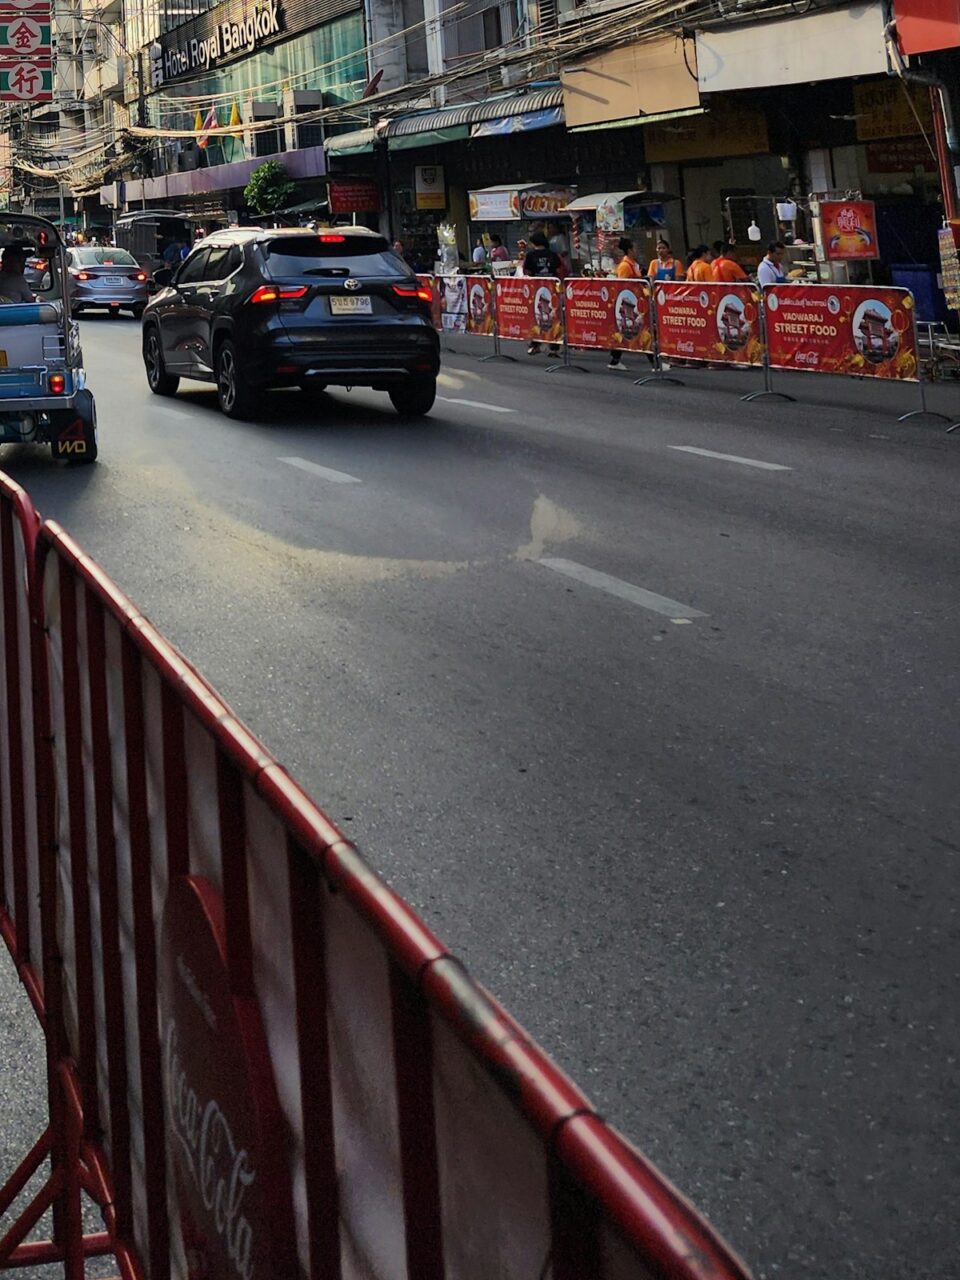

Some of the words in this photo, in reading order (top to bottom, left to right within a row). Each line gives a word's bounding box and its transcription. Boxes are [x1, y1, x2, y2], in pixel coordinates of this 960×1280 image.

[164, 41, 190, 78] Hotel
[191, 26, 221, 70] Royal
[222, 0, 280, 52] Bangkok
[591, 310, 607, 319] FOOD
[782, 312, 824, 322] YAOWARAJ
[662, 315, 686, 326] STREET
[687, 317, 707, 327] FOOD
[774, 322, 808, 334] STREET
[809, 324, 838, 336] FOOD
